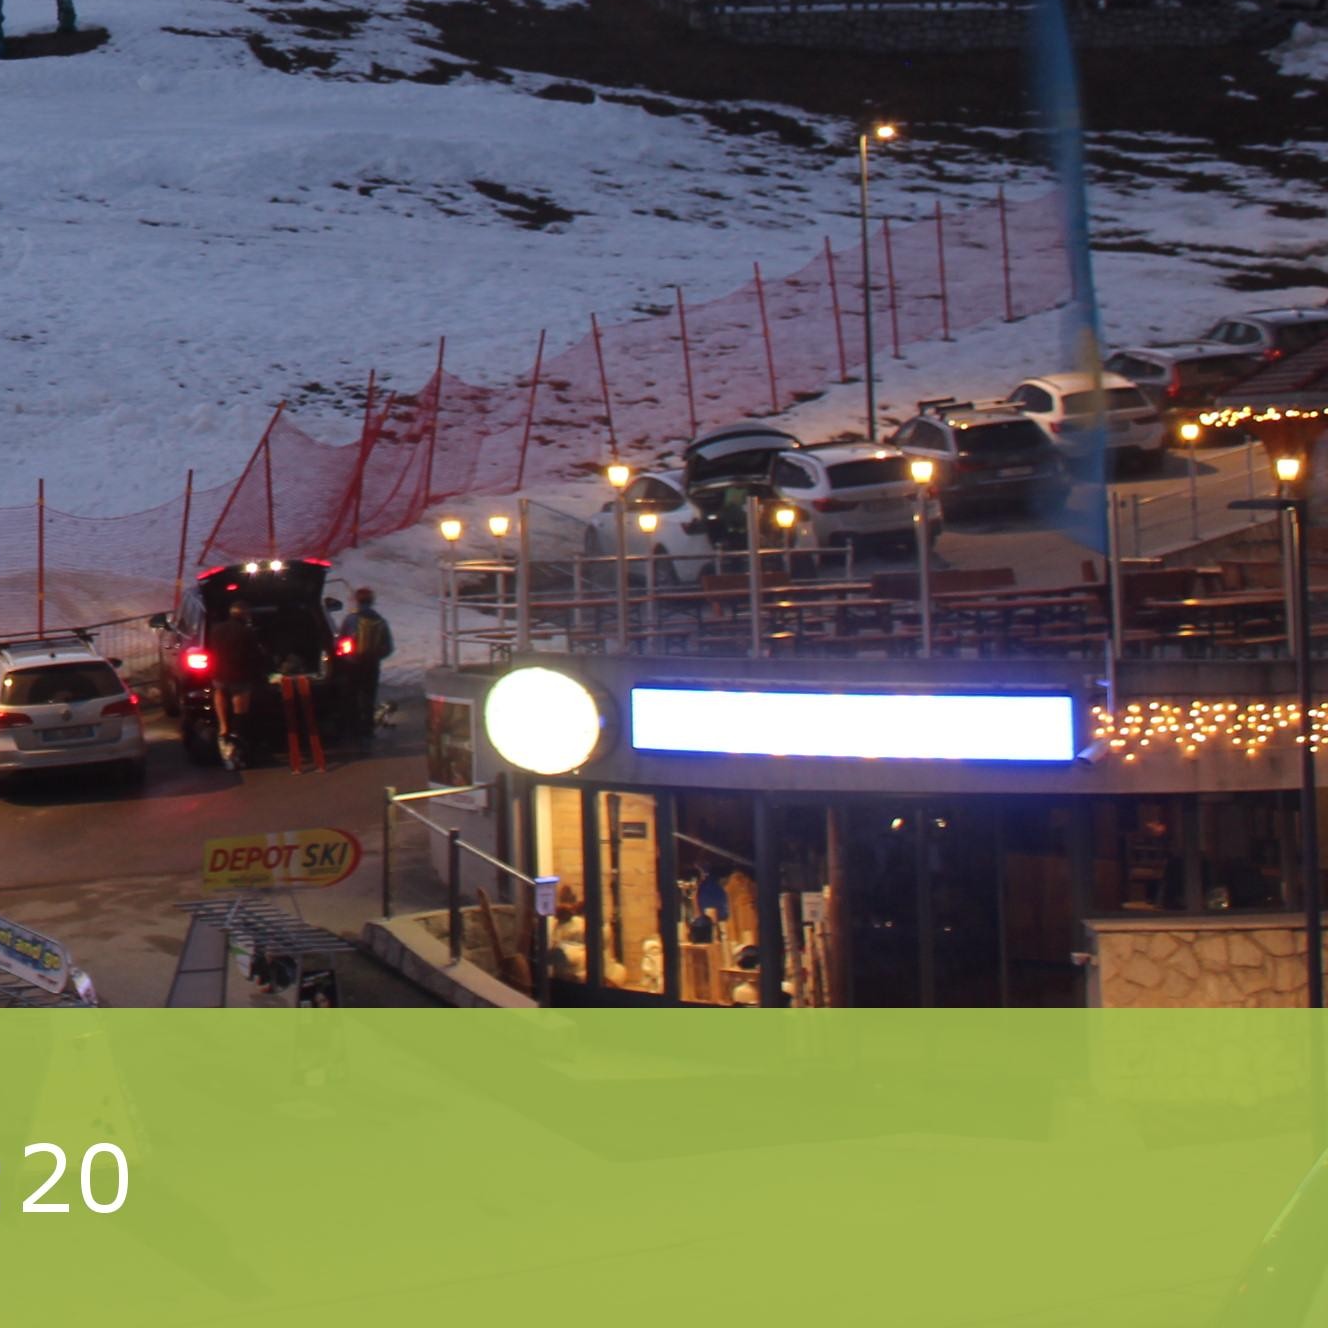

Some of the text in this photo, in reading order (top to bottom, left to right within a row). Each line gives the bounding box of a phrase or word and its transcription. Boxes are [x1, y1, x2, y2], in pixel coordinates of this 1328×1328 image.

[208, 842, 349, 872] DEPOT SKI
[15, 937, 43, 960] and
[43, 951, 62, 970] go
